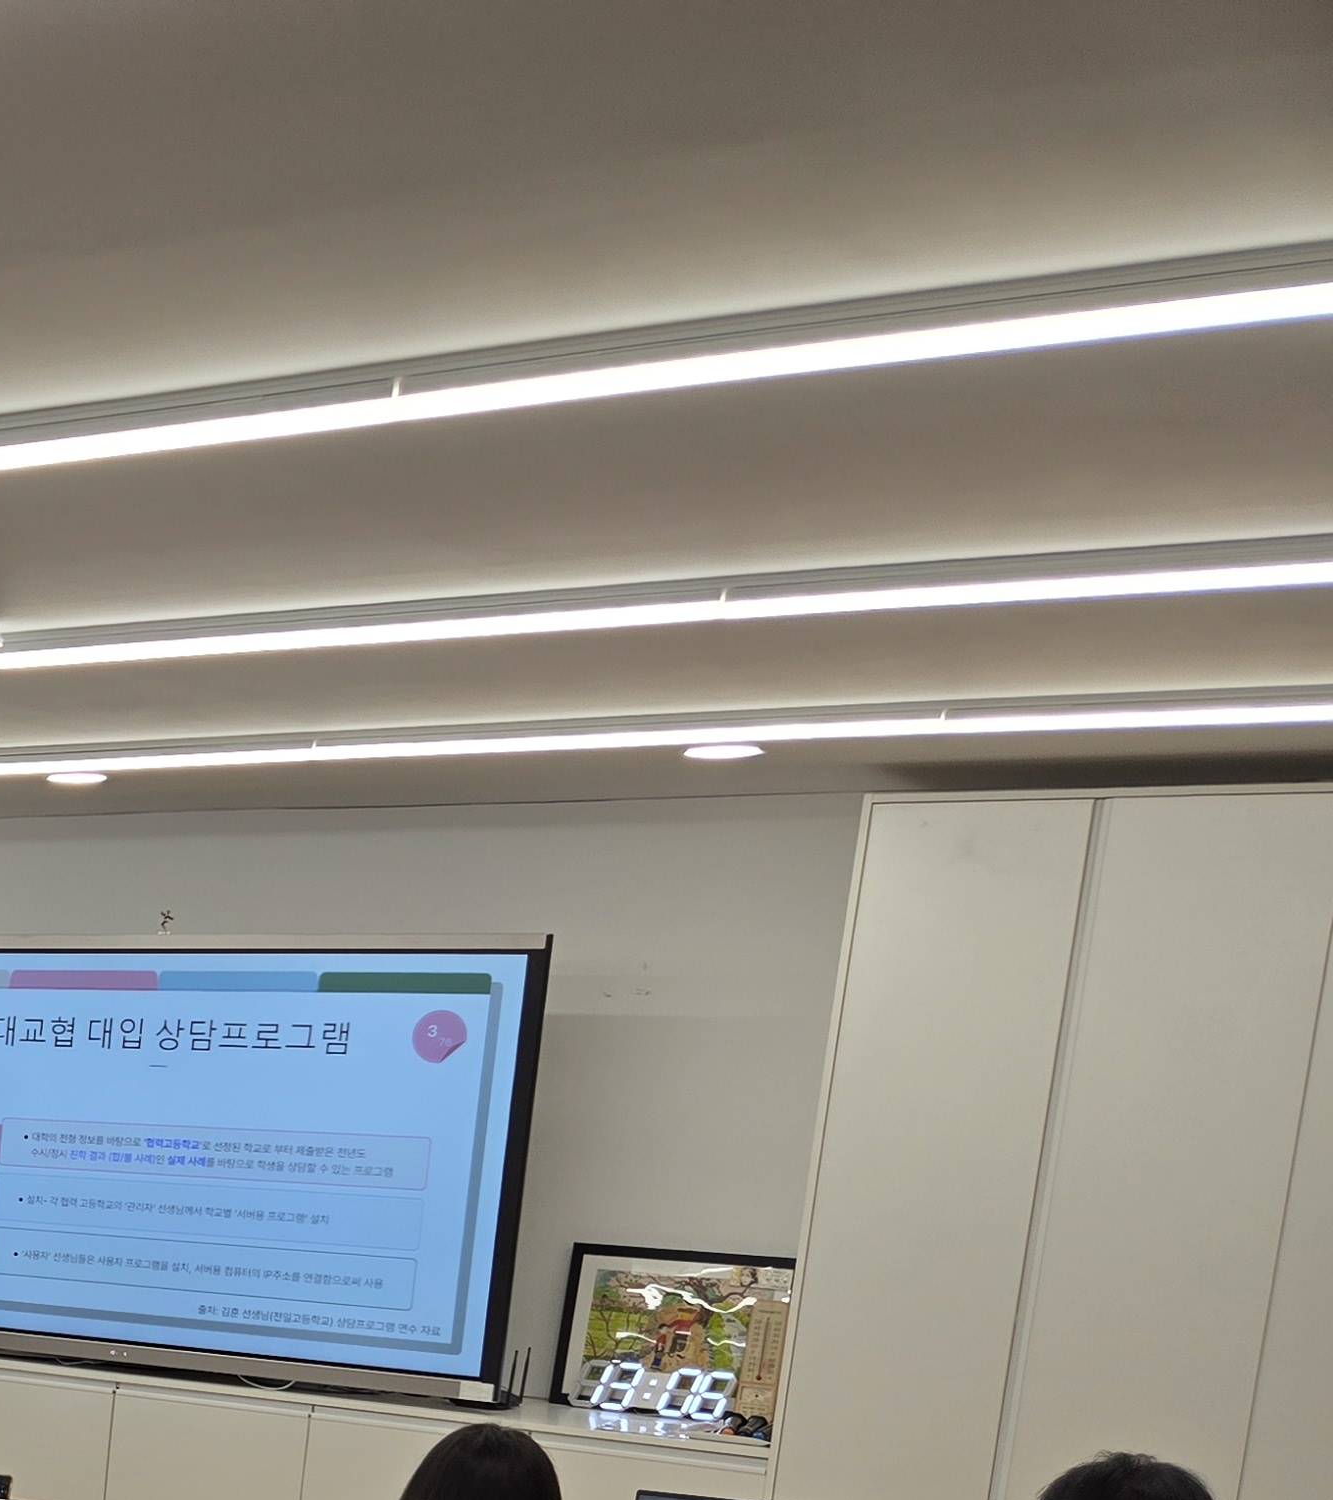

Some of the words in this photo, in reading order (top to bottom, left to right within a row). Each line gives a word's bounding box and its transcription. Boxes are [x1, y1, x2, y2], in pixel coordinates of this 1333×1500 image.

[88, 1017, 144, 1050] 대입
[155, 1018, 351, 1056] 상담프로그램
[427, 1024, 438, 1038] 3
[32, 1132, 57, 1143] 대학의
[59, 1133, 77, 1144] 전형
[78, 1134, 104, 1146] 정보를
[106, 1135, 140, 1147] 바탕으로
[213, 1142, 241, 1153] 선정된
[244, 1143, 271, 1154] 학교로
[274, 1144, 293, 1155] 부터
[296, 1146, 334, 1157] 제출받은
[337, 1148, 367, 1159] 전년도
[69, 1149, 87, 1161] 진학
[89, 1150, 106, 1162] 결과
[167, 1155, 185, 1167] 실제
[188, 1156, 214, 1168] 사례를
[217, 1158, 254, 1170] 바탕으로
[257, 1160, 284, 1172] 학생을
[287, 1161, 315, 1173] 상담할
[319, 1163, 327, 1174] 수
[331, 1164, 350, 1175] 있는
[353, 1165, 393, 1178] 프로그램
[50, 1196, 58, 1206] 각
[61, 1197, 77, 1208] 협력
[80, 1198, 122, 1210] 고등학교의
[158, 1204, 202, 1216] 선생님께서
[205, 1206, 232, 1218] 학교별
[310, 1213, 329, 1225] 설치
[53, 1252, 95, 1265] 선생님들은
[97, 1255, 123, 1267] 사용자
[125, 1257, 169, 1271] 프로그램을
[194, 1264, 221, 1276] 서버용
[224, 1266, 260, 1279] 컴퓨터의
[263, 1268, 300, 1282] IP주소를
[303, 1271, 361, 1287] 연결함으로써
[363, 1277, 383, 1289] 사용
[198, 1304, 218, 1316] 출처:
[337, 1317, 395, 1333] 상담프로그램
[398, 1322, 418, 1334] 연수
[420, 1324, 441, 1337] 자료
[589, 1360, 737, 1422] 13:06
